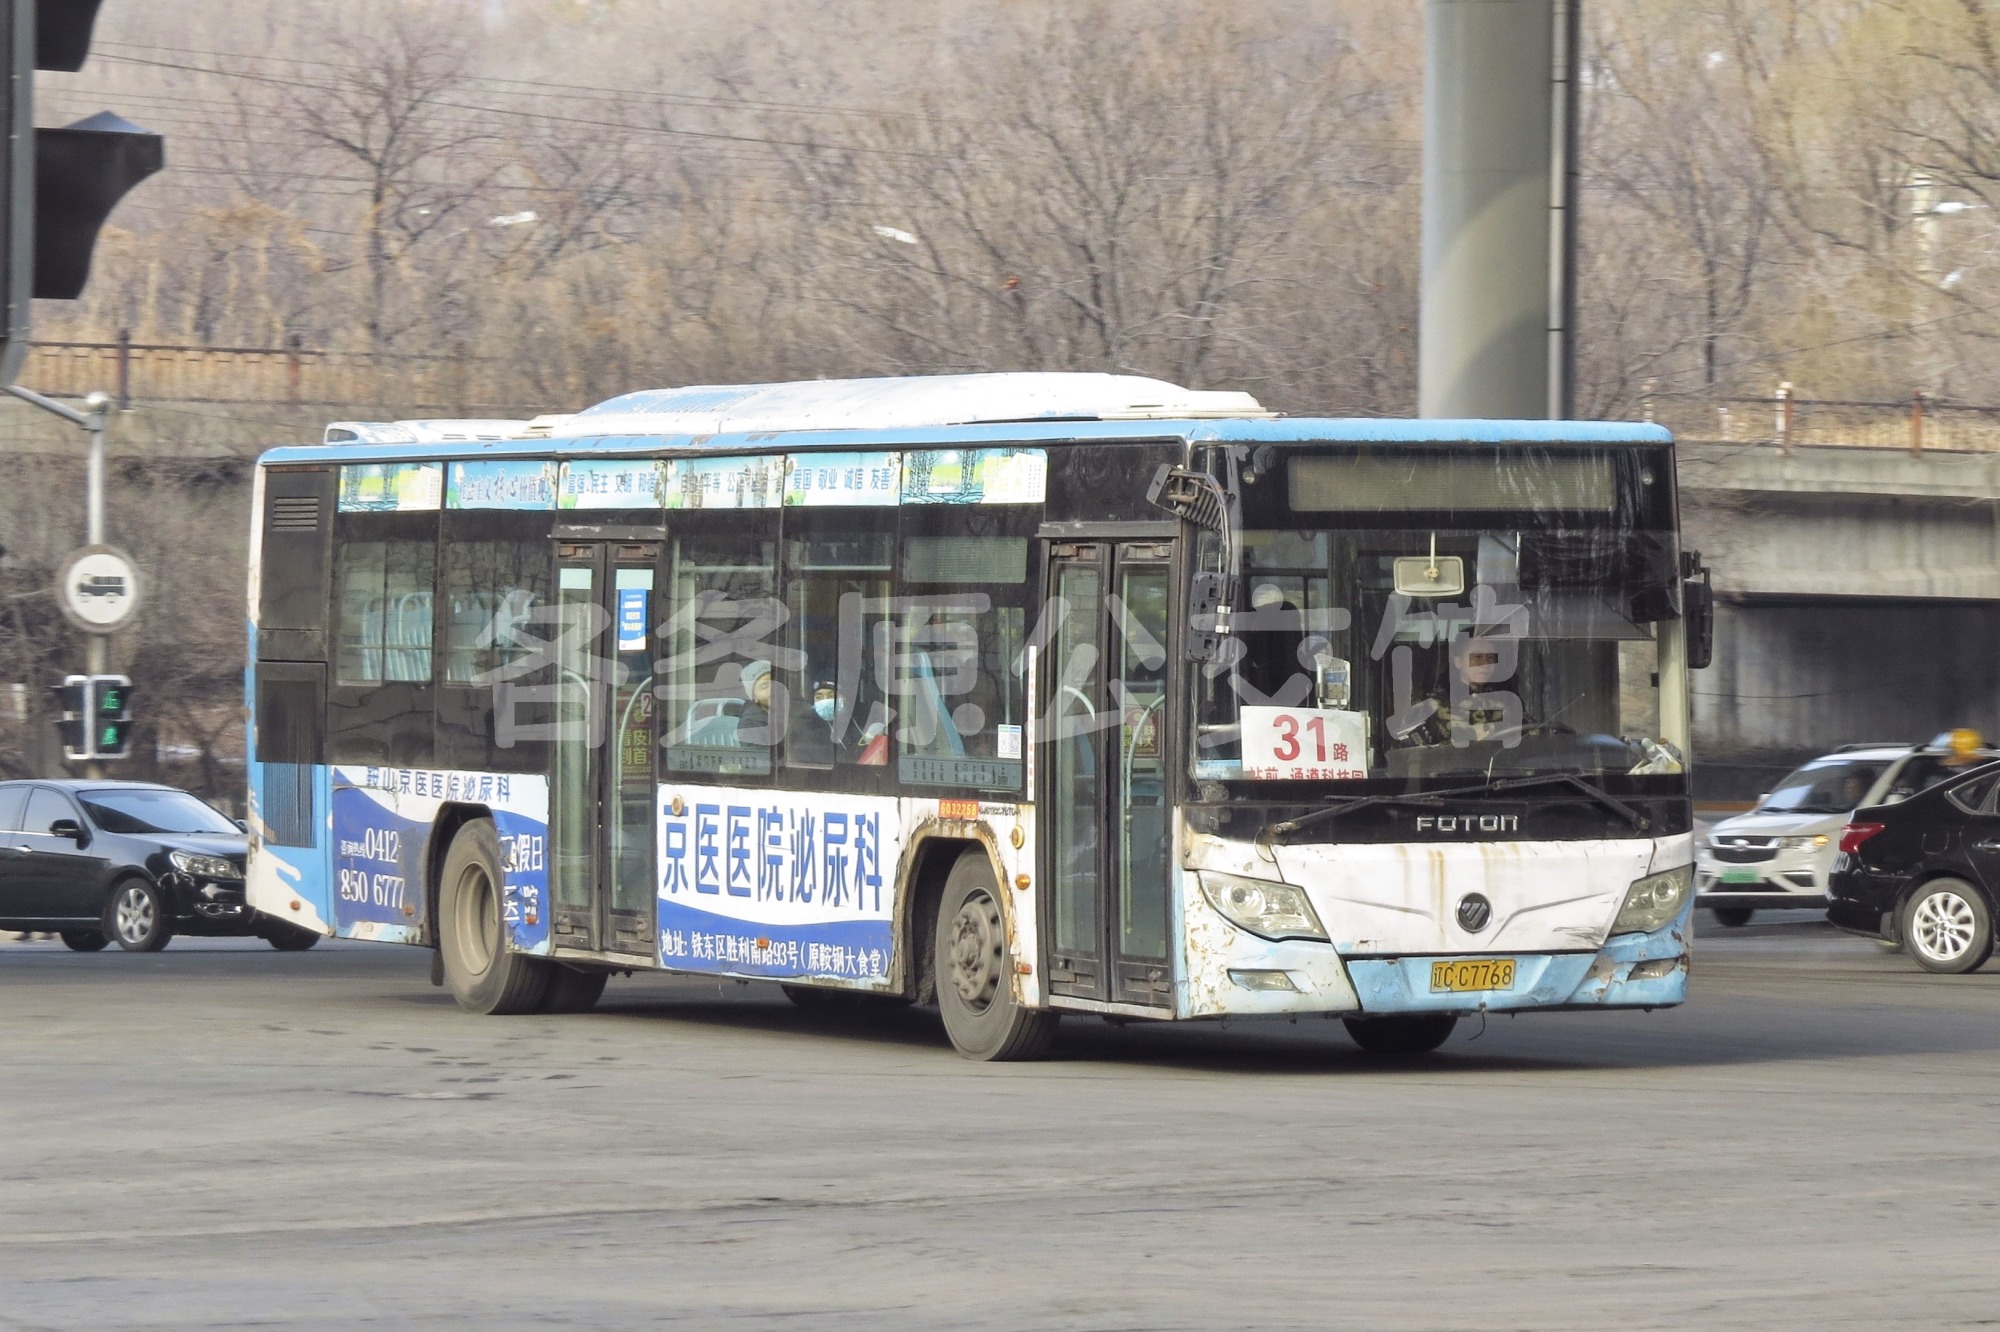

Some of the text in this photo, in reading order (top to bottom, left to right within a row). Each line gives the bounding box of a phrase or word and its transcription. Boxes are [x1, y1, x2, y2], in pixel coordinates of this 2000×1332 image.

[568, 474, 585, 494] 富强
[591, 473, 608, 494] 民主
[703, 472, 721, 494] 平等
[793, 468, 812, 491] 爱国
[818, 468, 838, 491] 敬业
[844, 468, 864, 491] 诚信
[871, 468, 891, 490] 友善
[940, 801, 978, 817] 6032258
[1416, 814, 1519, 832] FOTON
[663, 803, 883, 912] 京医医院泌尿科
[341, 868, 405, 909] 850 6777
